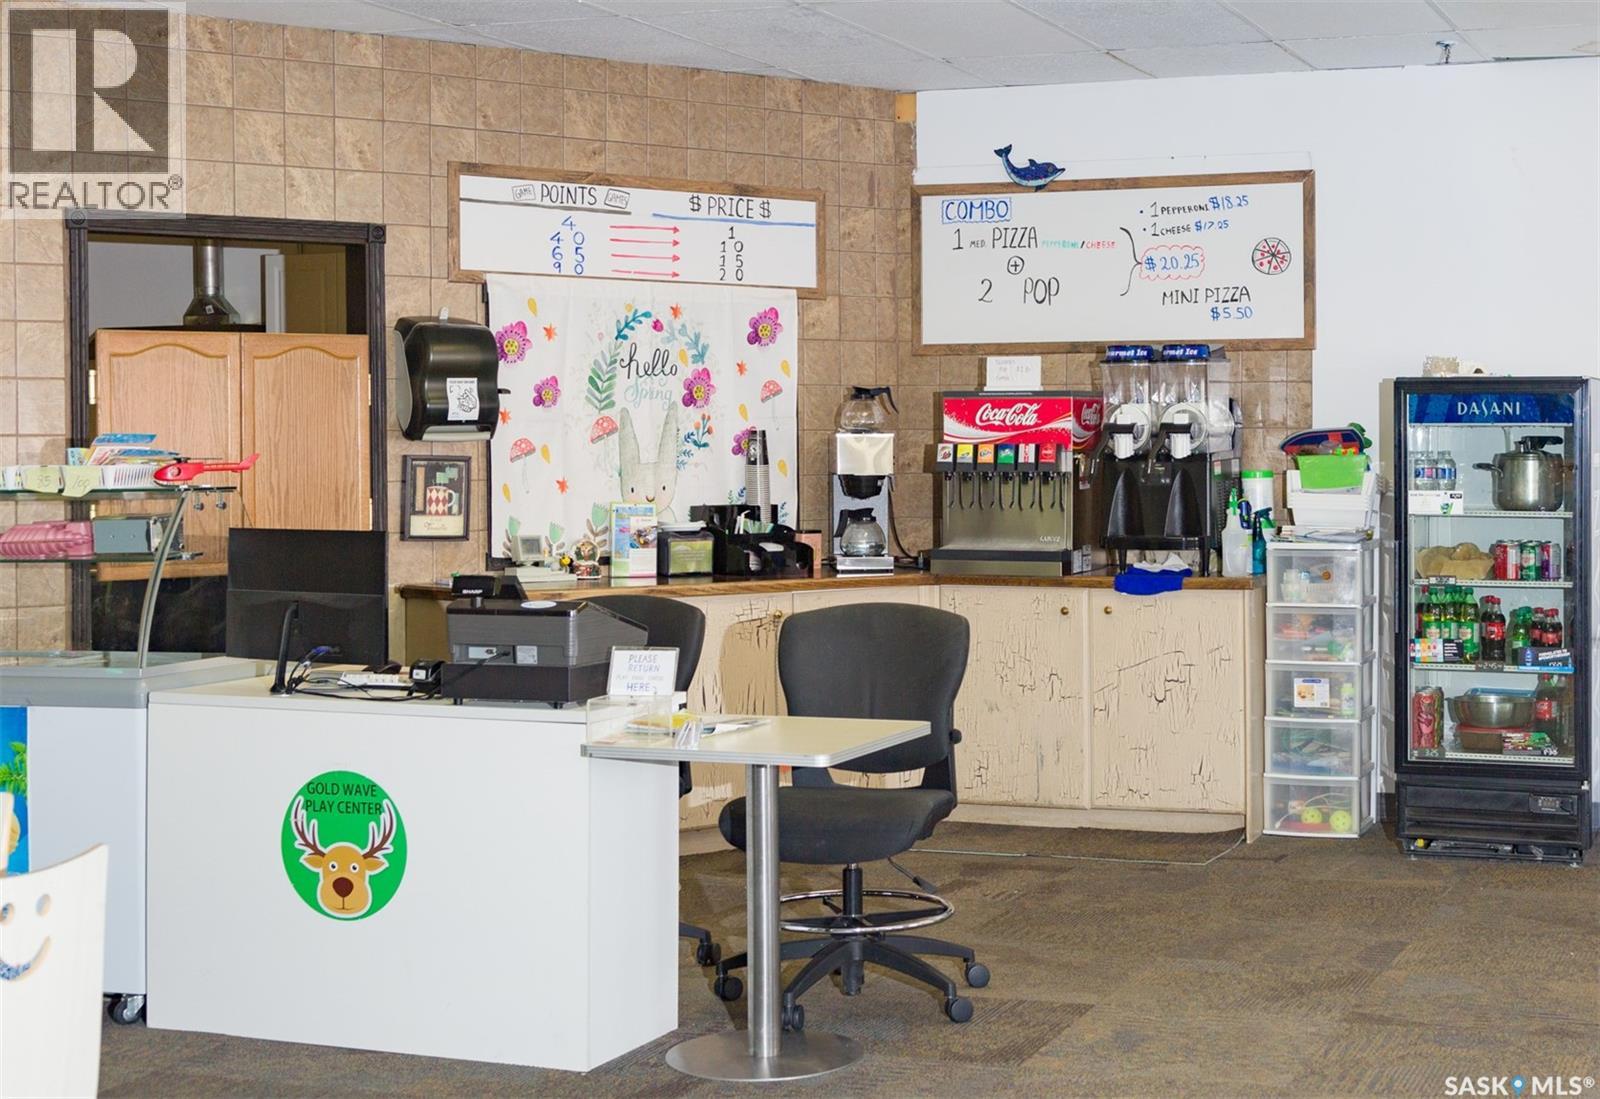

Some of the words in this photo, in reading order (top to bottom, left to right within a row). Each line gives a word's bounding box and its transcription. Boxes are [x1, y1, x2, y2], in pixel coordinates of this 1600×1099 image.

[540, 183, 598, 206] POINTS
[707, 196, 755, 219] PRICE
[945, 199, 1009, 220] COMBO
[1150, 202, 1159, 217] 1
[1160, 203, 1209, 215] PEPPERONI
[561, 216, 576, 231] 4
[1151, 222, 1159, 236] 1
[1161, 224, 1191, 236] CHEESE
[728, 226, 735, 239] 1
[952, 228, 963, 250] 1
[992, 226, 1038, 249] PIZZA
[978, 278, 993, 303] 2
[1024, 277, 1060, 306] POP
[1162, 288, 1199, 305] MINI
[1205, 286, 1251, 303] PIZZA
[620, 342, 677, 379] hello
[975, 402, 1042, 426] Coca-Cola
[1457, 400, 1521, 416] DASANI
[628, 654, 658, 664] PLEASE
[306, 781, 340, 796] GOLD
[343, 783, 377, 797] WAVE
[305, 799, 335, 813] PLAY
[337, 801, 382, 815] CENTER
